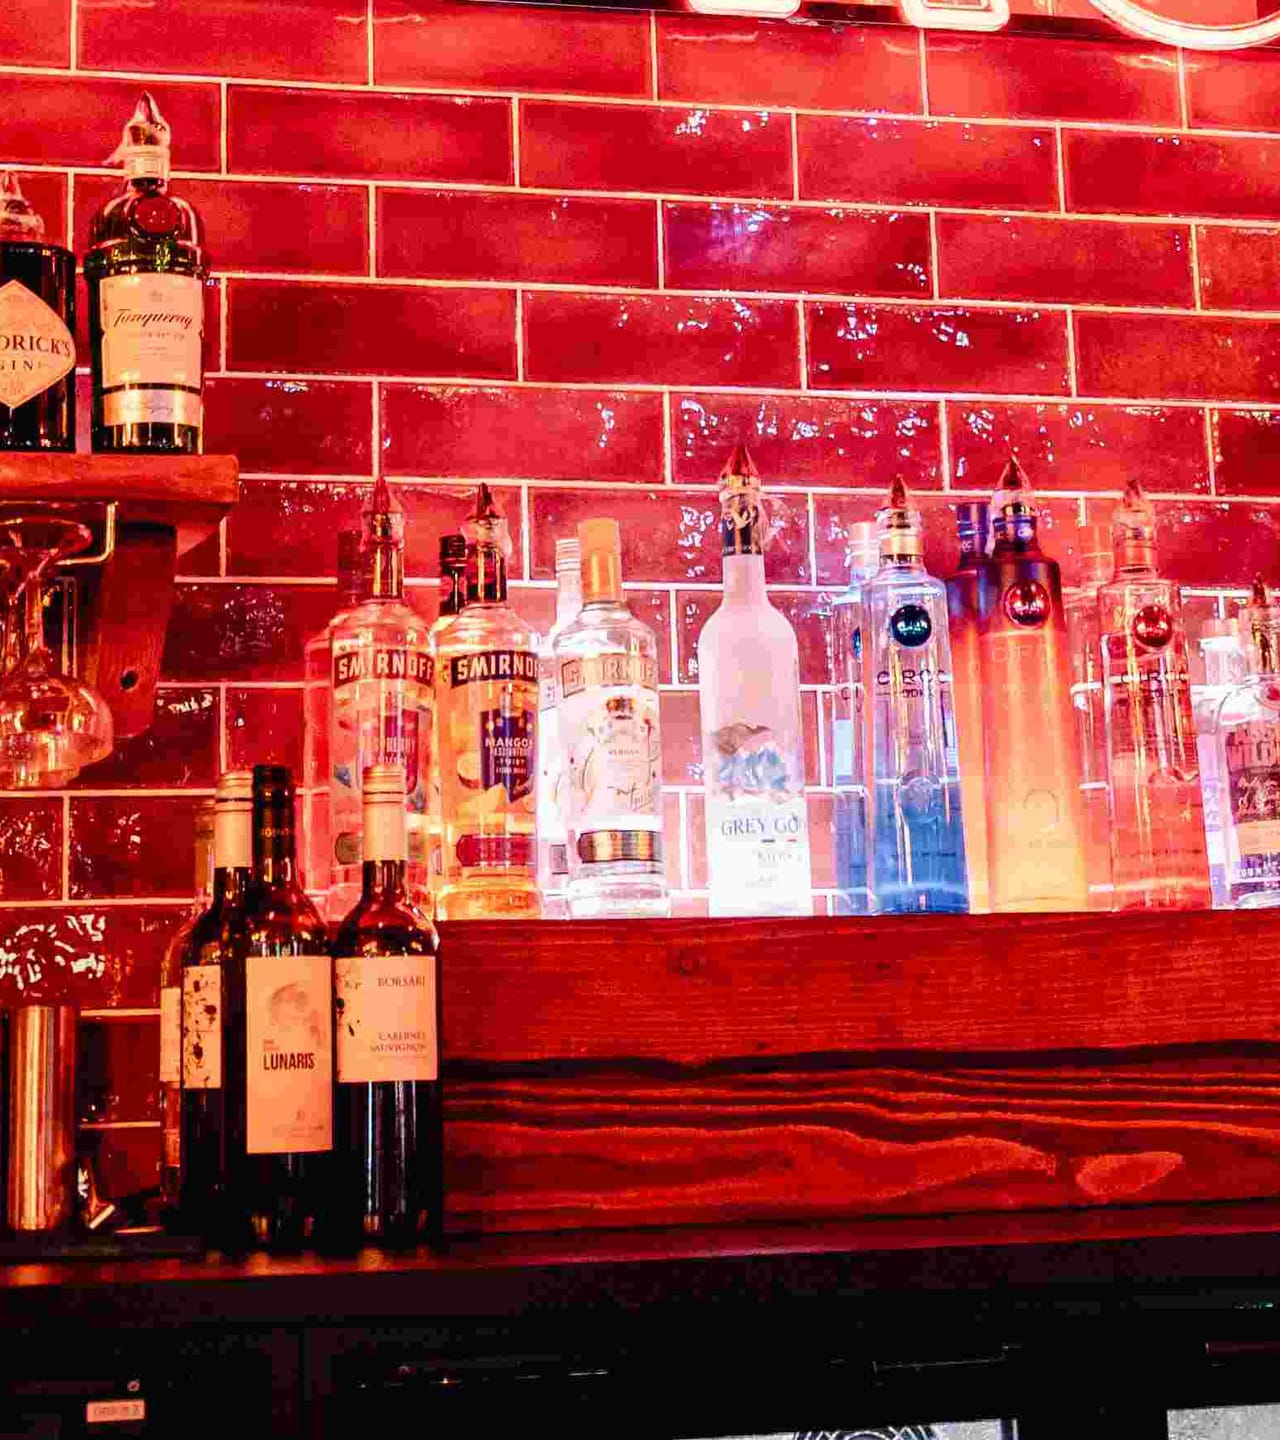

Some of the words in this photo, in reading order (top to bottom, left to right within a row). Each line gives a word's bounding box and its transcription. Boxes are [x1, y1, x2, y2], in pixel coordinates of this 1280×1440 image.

[114, 308, 194, 330] Tanqueray
[338, 651, 434, 681] SMIRNOFF
[721, 817, 766, 836] GREY
[263, 1052, 315, 1071] LUNARIS
